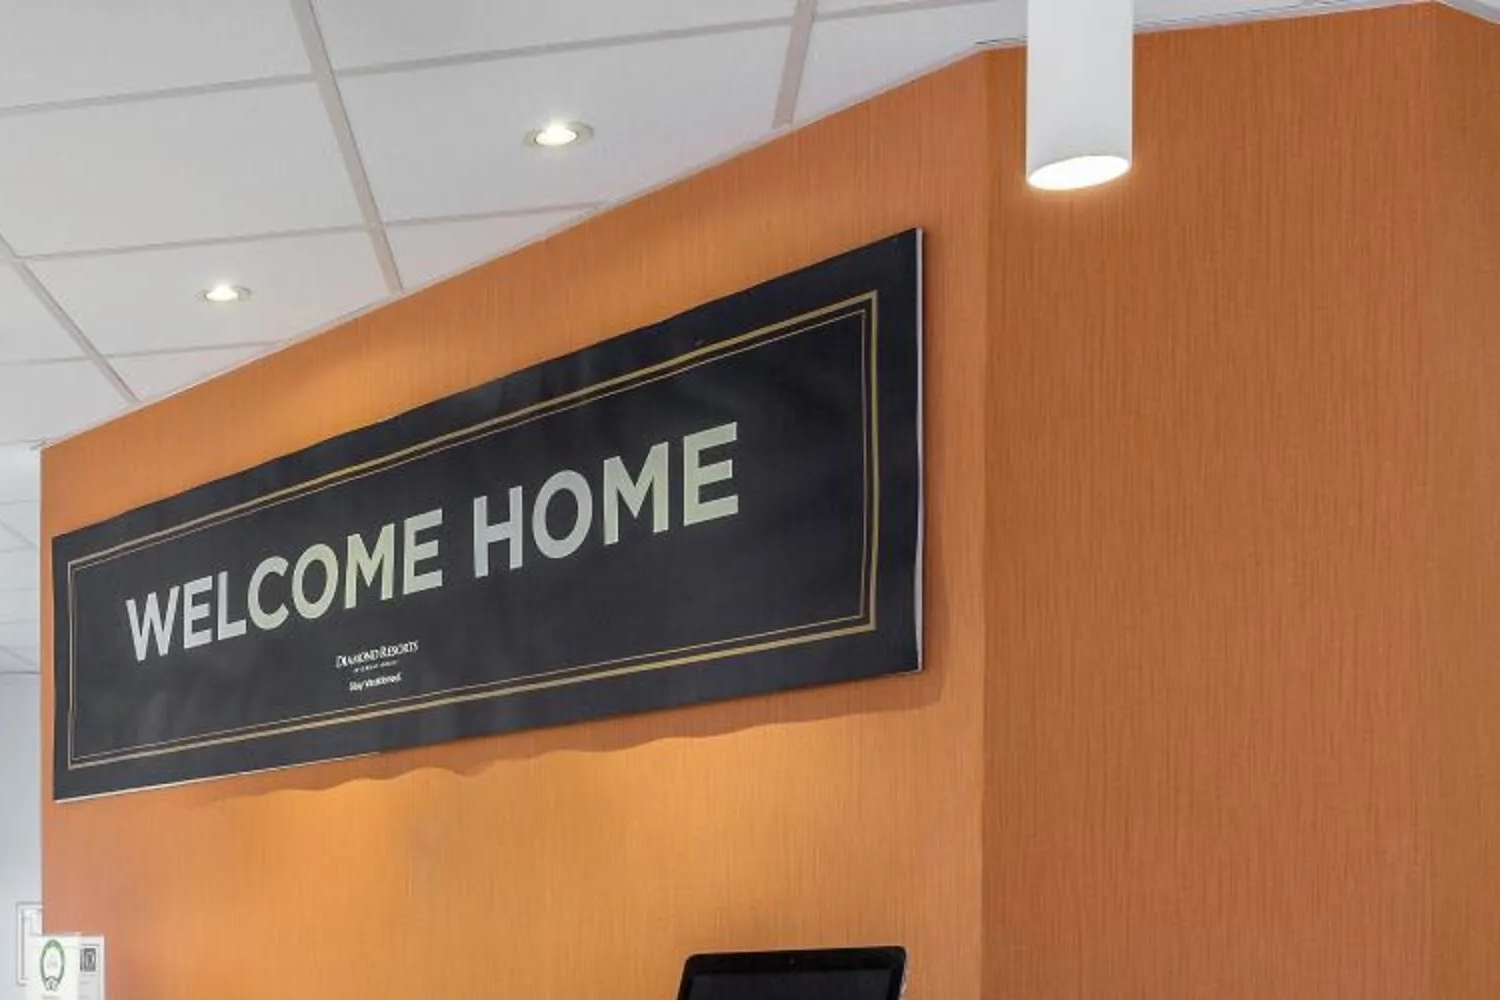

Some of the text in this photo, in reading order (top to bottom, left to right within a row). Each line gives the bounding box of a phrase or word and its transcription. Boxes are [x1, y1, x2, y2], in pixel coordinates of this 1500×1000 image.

[125, 421, 740, 662] WELCOME HOME
[380, 640, 419, 658] RESORTS
